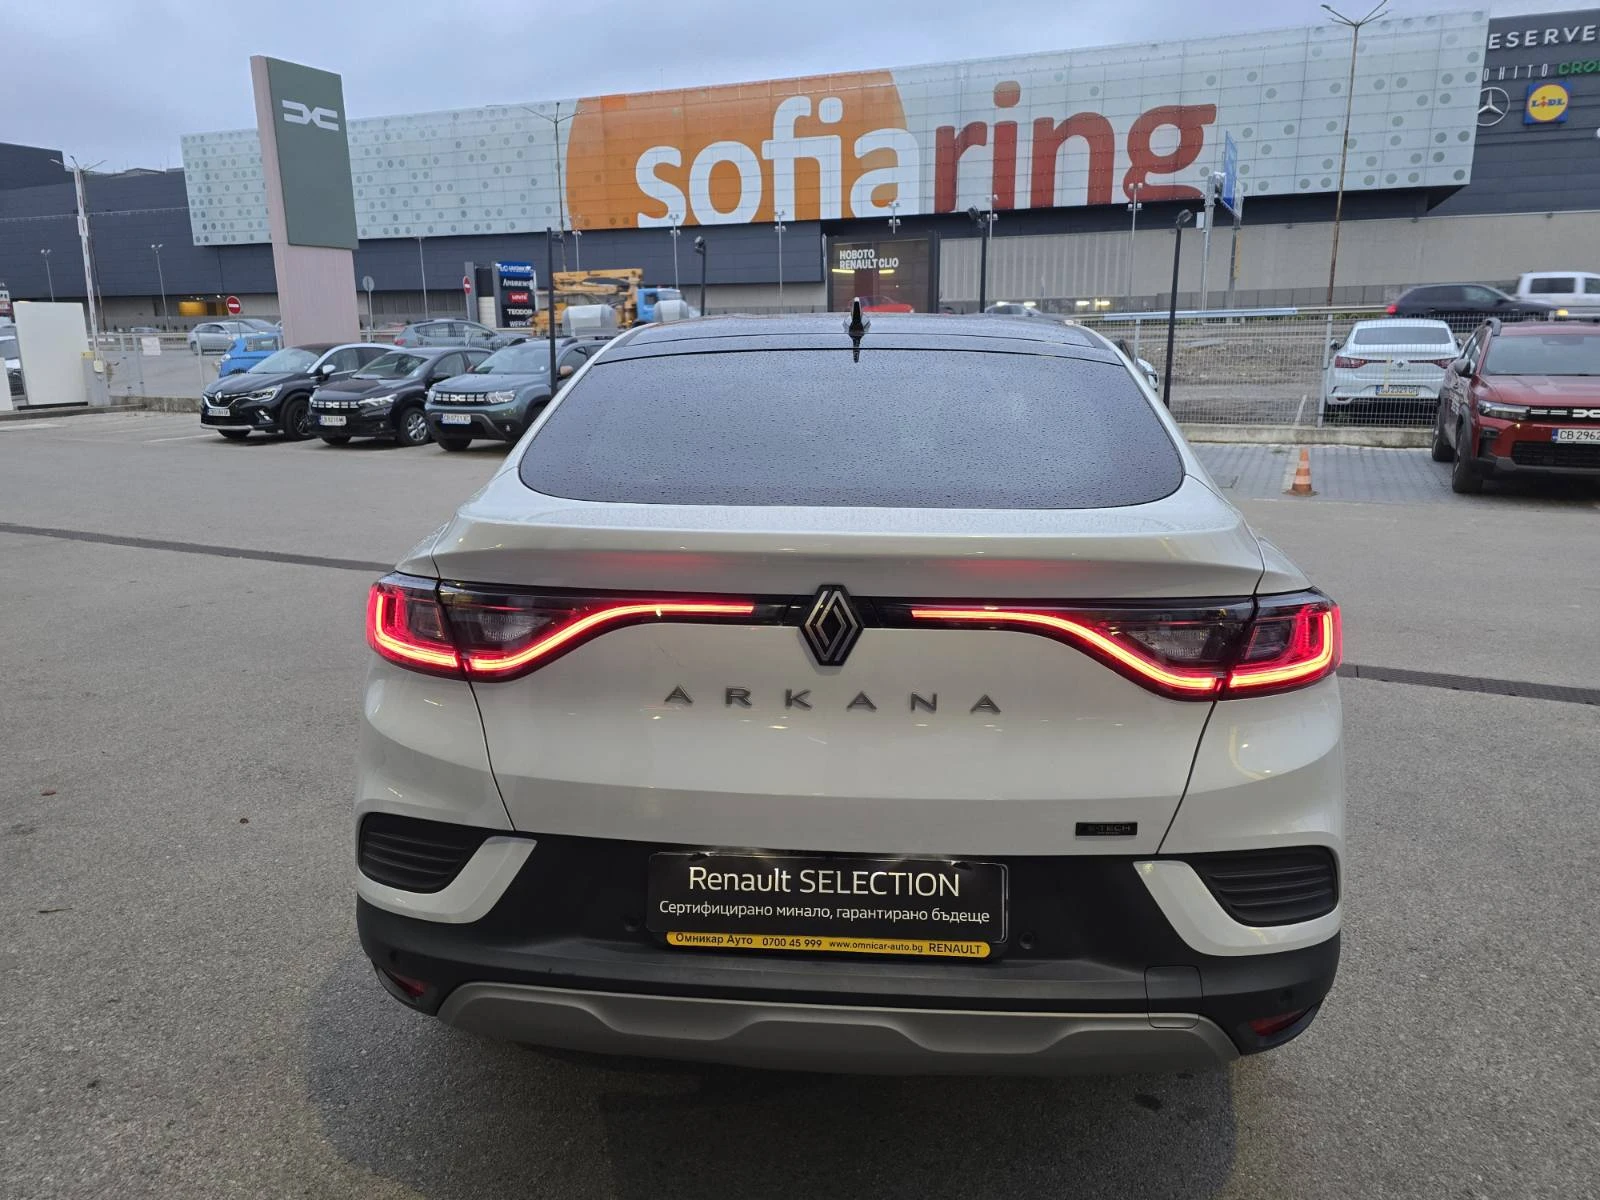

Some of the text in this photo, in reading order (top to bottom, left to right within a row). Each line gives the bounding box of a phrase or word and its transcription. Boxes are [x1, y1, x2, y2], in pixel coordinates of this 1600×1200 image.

[1488, 25, 1600, 49] ESERVE
[1484, 63, 1548, 82] OHITO
[1559, 60, 1600, 74] CRO
[839, 257, 899, 269] RENAULT CLIO
[664, 684, 1002, 715] ARKANA
[689, 866, 960, 897] Renault SELECTION
[659, 901, 990, 924] Сертифицирано минало, гарантирано бъдеще
[675, 932, 982, 954] Омникар Ауто 0700 45 999 www.omnicar-auto.bg RENAULT
